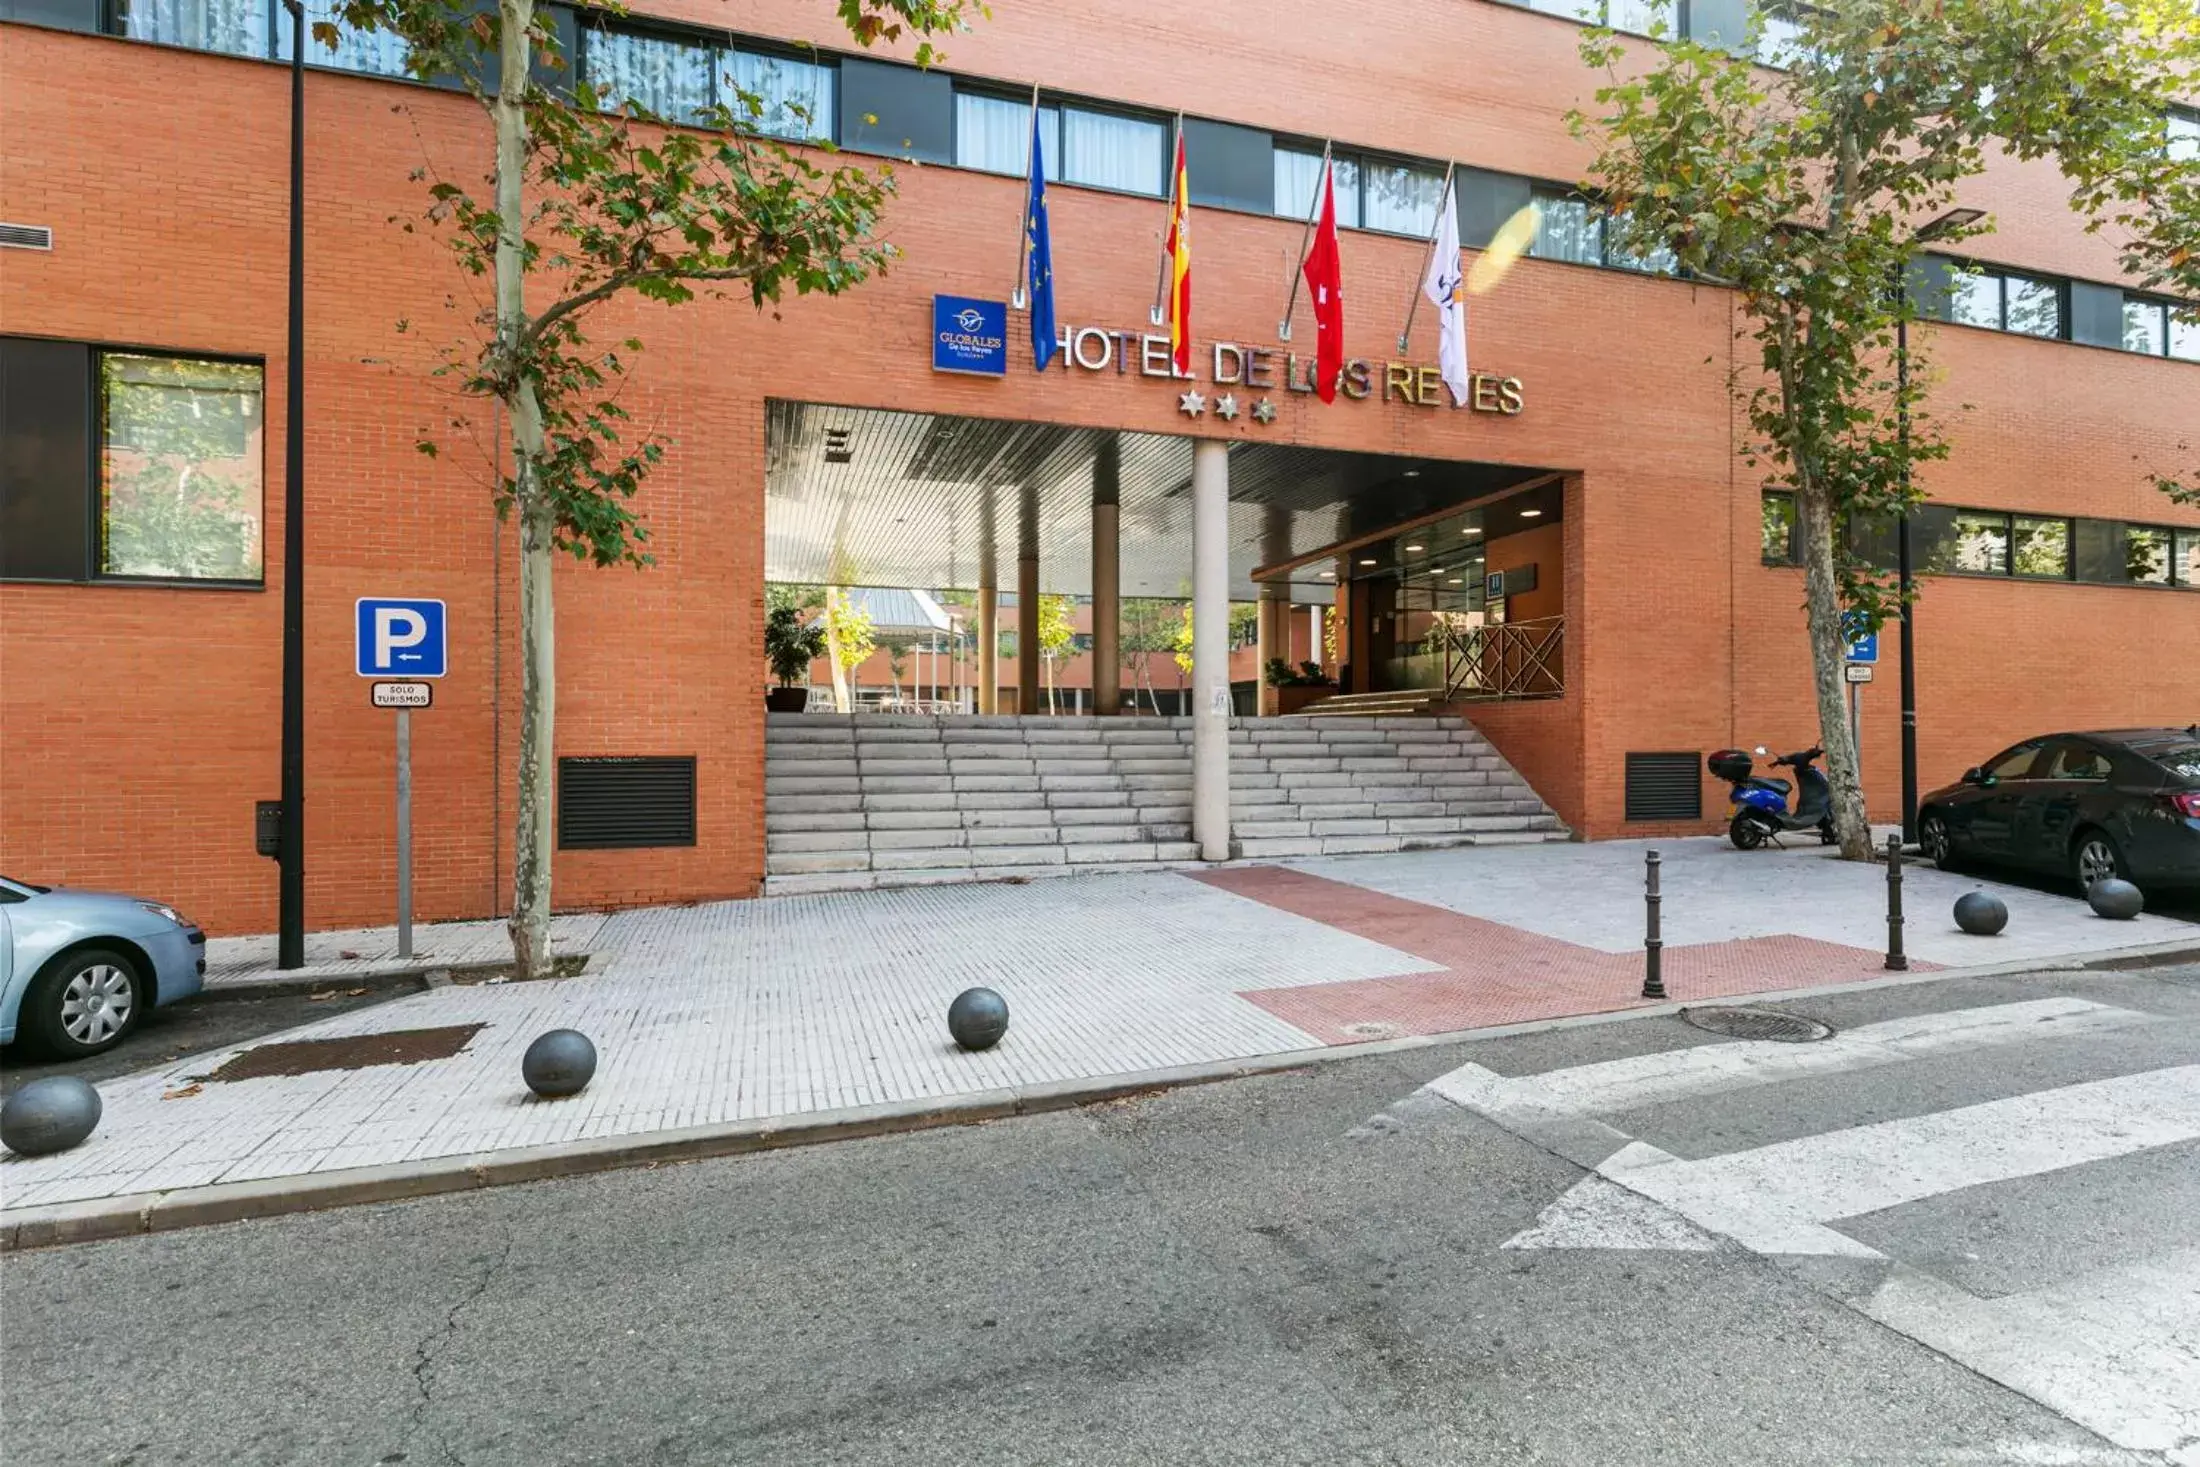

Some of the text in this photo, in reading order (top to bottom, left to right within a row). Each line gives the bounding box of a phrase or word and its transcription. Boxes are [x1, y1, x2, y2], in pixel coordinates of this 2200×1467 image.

[940, 332, 1001, 348] GLOBALES
[1214, 342, 1275, 388] DE
[1384, 363, 1524, 414] REES
[375, 608, 427, 668] P
[377, 695, 426, 703] TURISMOS
